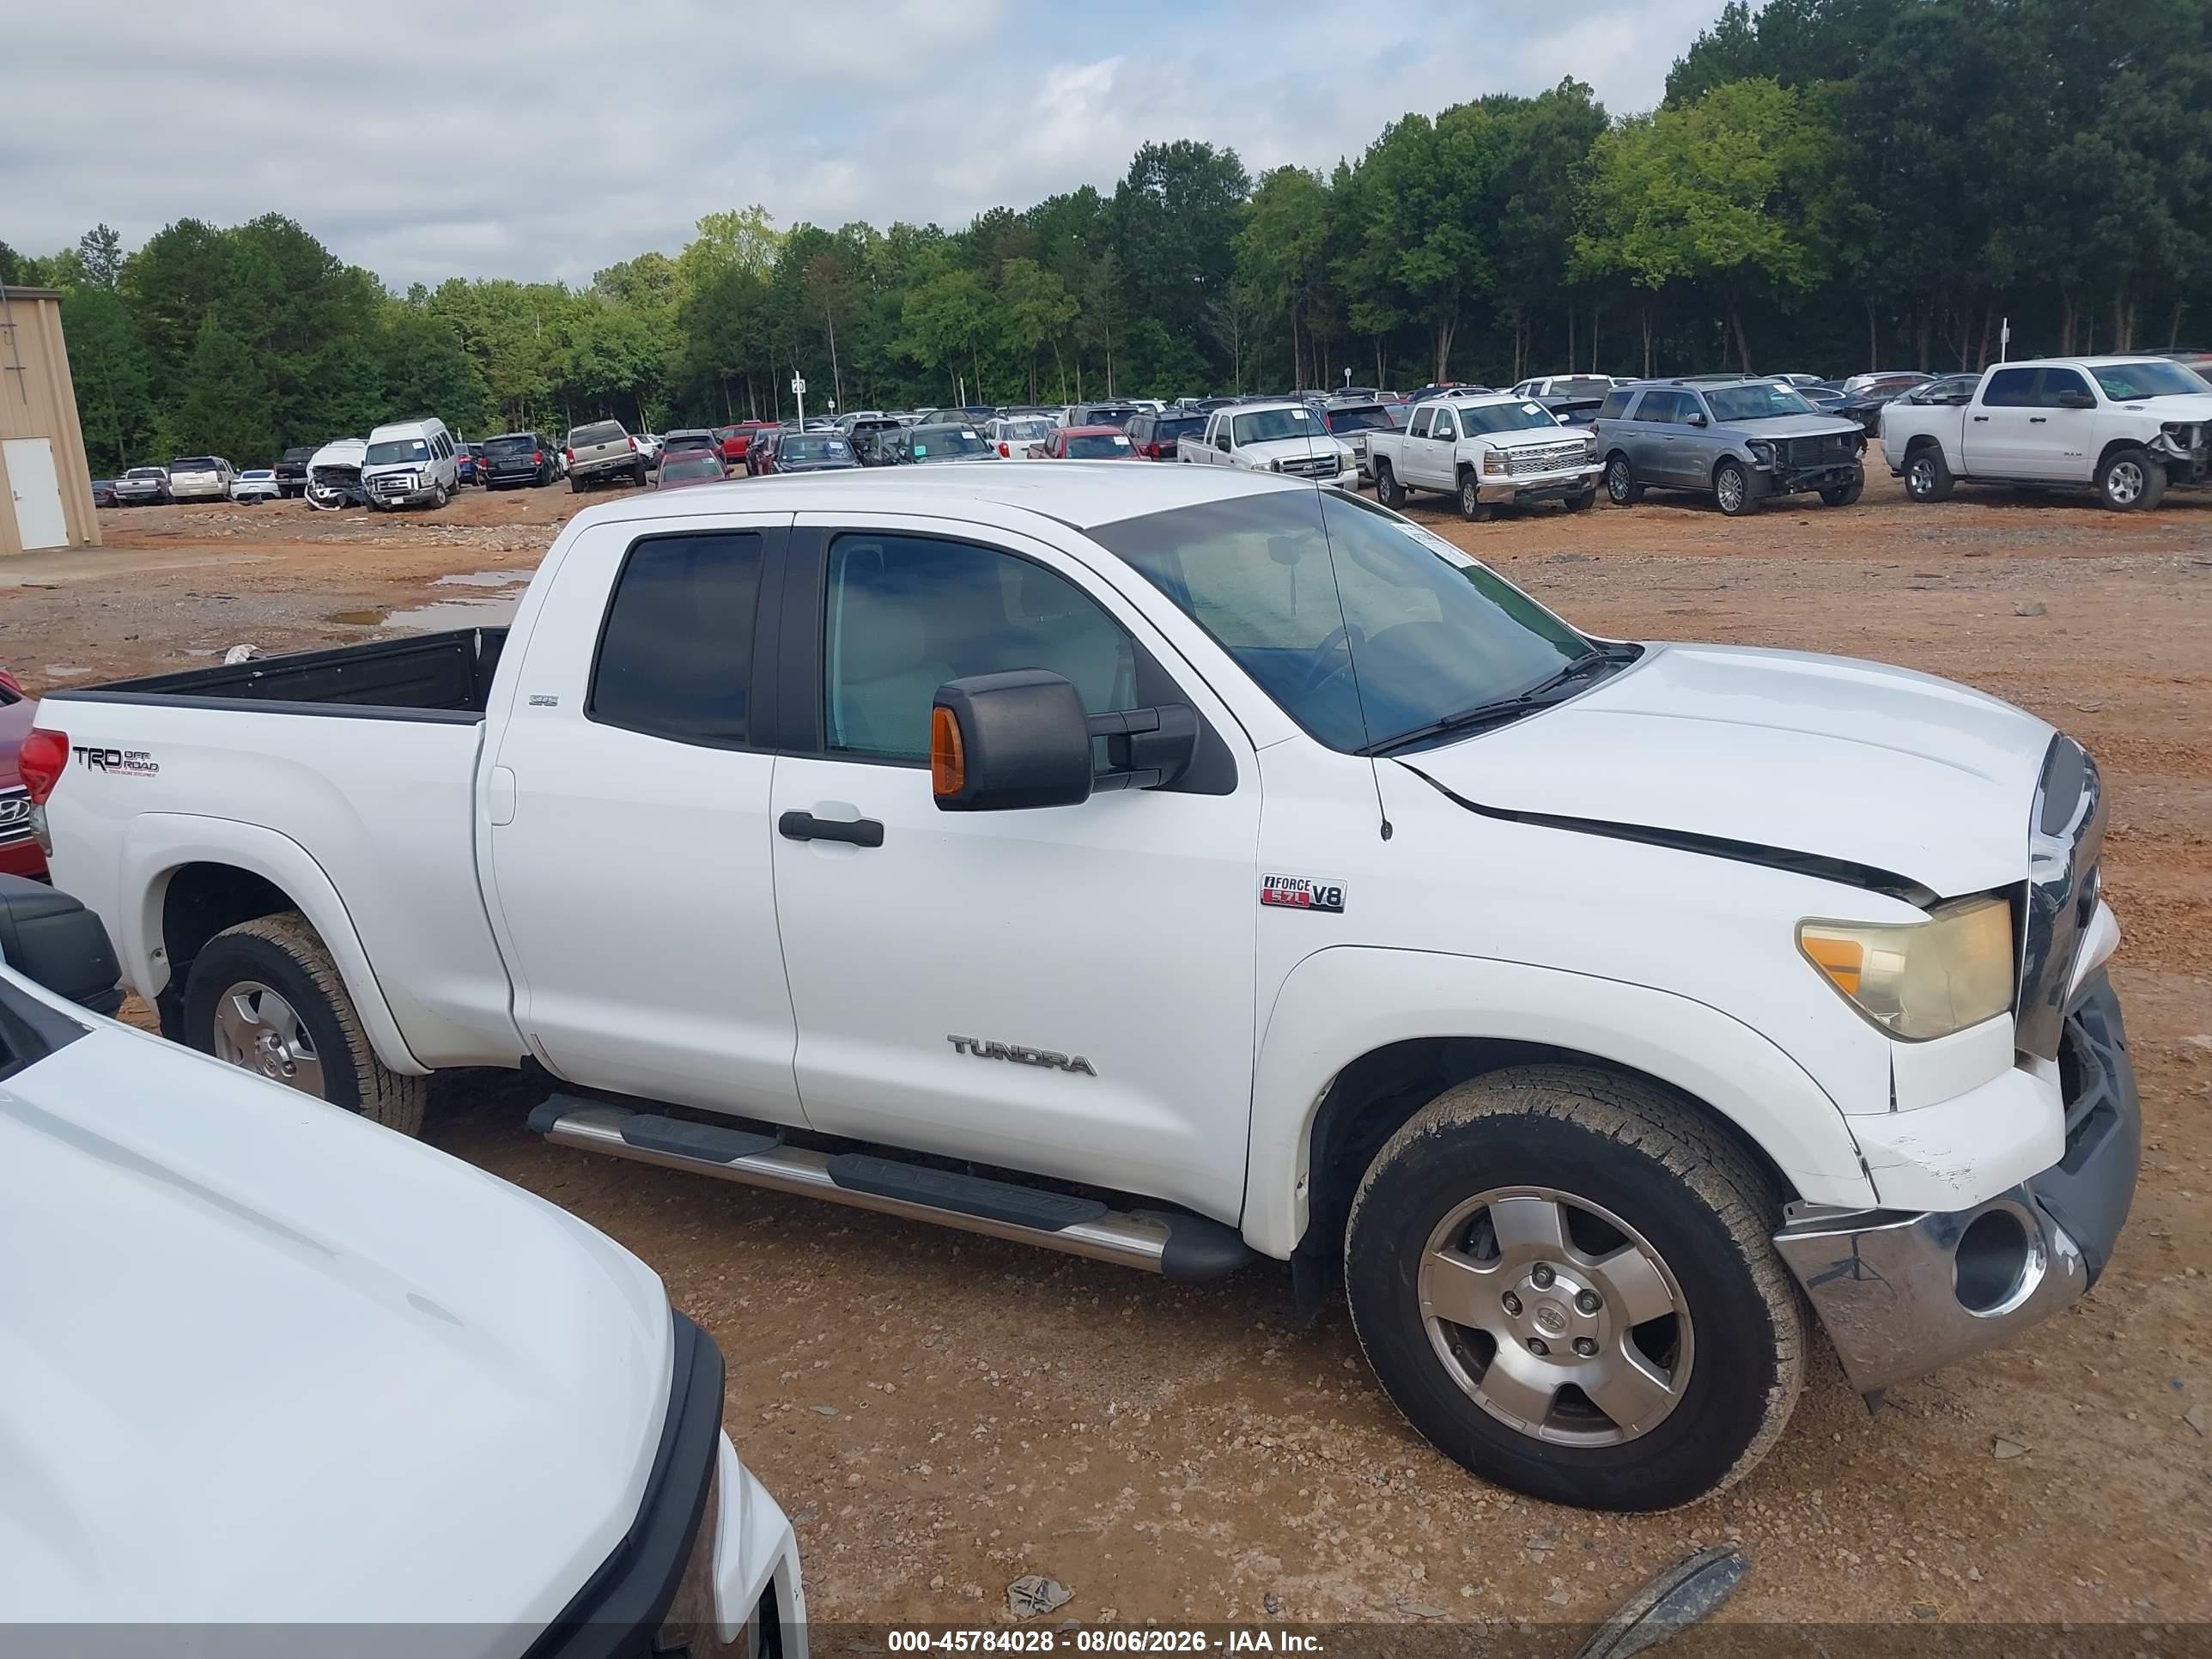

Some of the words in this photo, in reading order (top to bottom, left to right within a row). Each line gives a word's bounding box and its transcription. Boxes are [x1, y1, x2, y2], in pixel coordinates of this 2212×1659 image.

[73, 746, 122, 773] TRD
[125, 751, 151, 760] OFF
[124, 761, 159, 772] ROAD
[1271, 890, 1305, 905] 5.7L
[1312, 885, 1342, 906] V8
[947, 1034, 1098, 1076] TUNDRA
